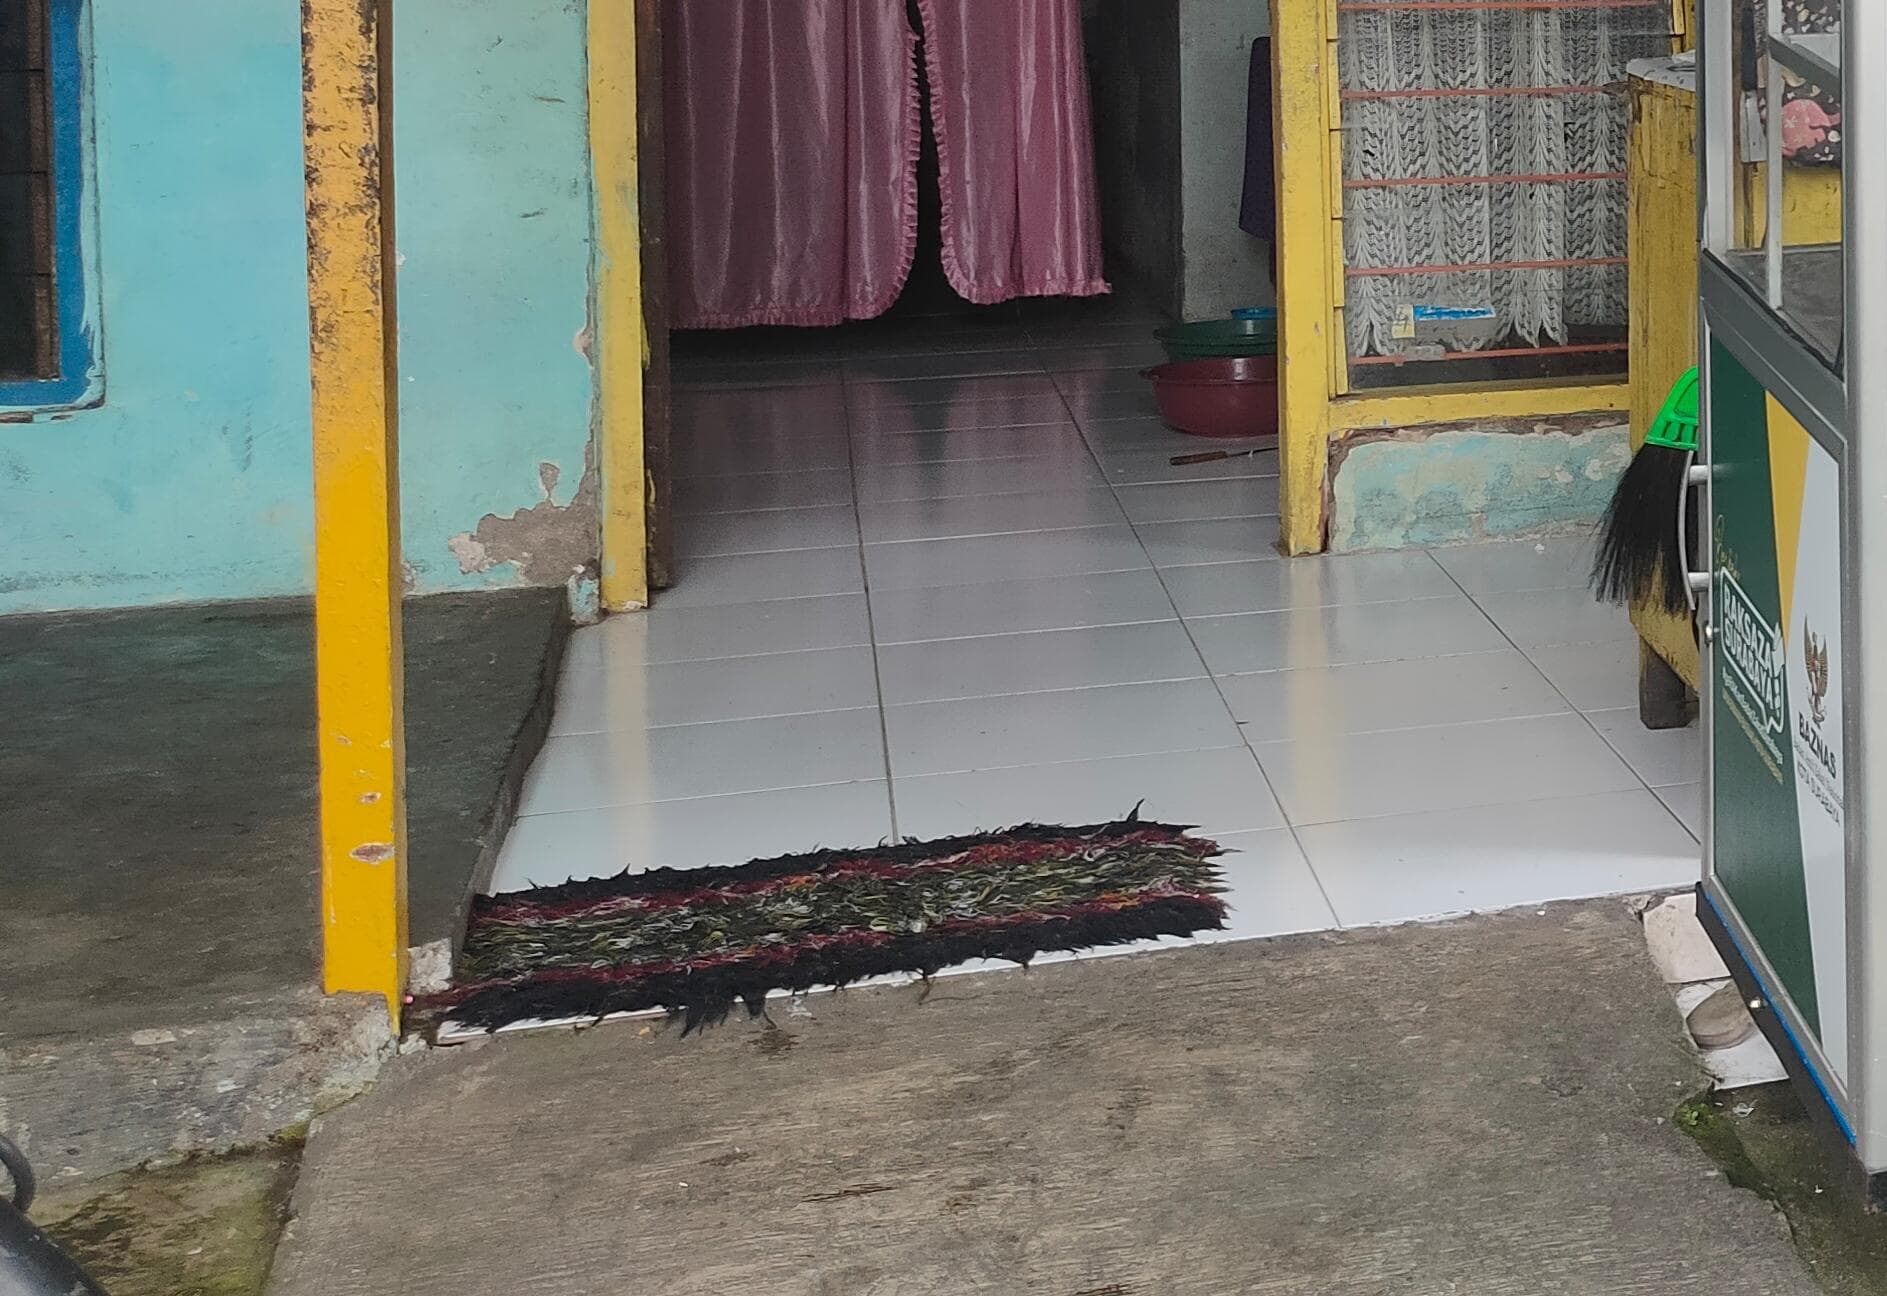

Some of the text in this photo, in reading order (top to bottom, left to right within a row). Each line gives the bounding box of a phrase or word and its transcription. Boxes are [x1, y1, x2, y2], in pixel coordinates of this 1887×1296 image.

[1724, 583, 1774, 679] RAKSAZA
[1724, 617, 1774, 710] SURABAYA
[1799, 712, 1837, 779] BAZNAS
